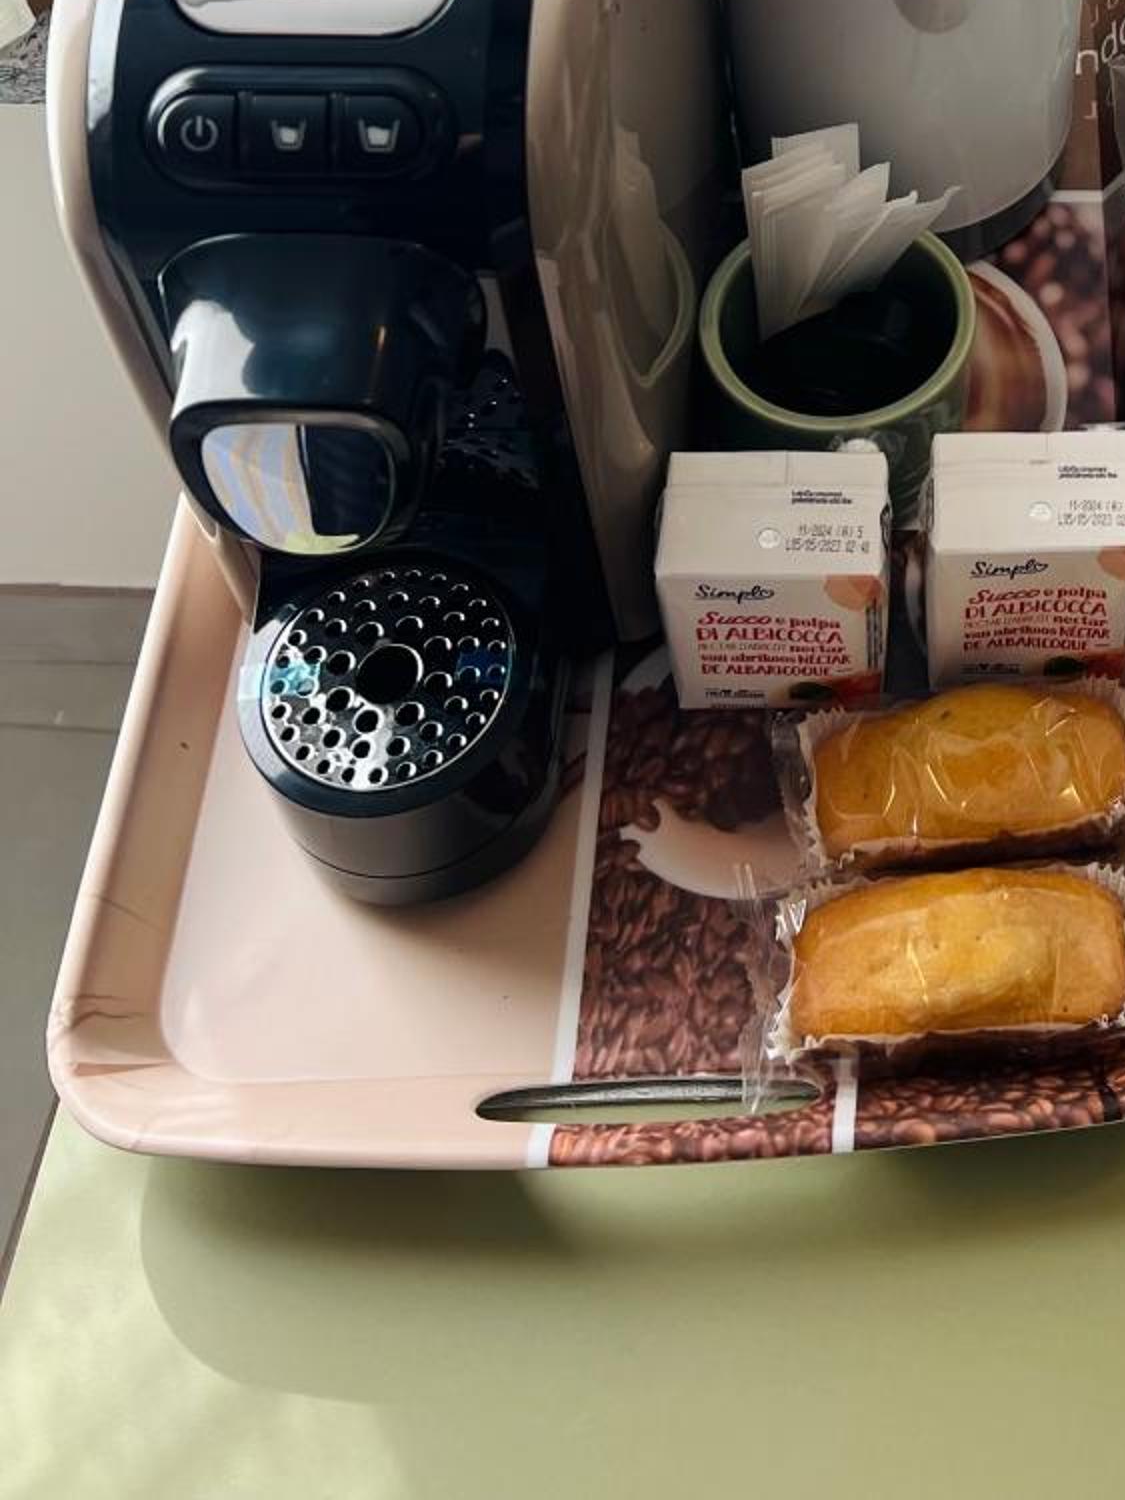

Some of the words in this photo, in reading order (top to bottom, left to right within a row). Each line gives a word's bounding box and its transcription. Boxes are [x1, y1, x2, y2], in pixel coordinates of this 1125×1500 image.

[968, 588, 1041, 604] Succo
[1056, 585, 1107, 600] polpa
[965, 605, 986, 620] DI
[992, 599, 1107, 618] ALBICOCCA
[698, 611, 771, 626] Succo
[789, 616, 841, 630] polpa
[1053, 615, 1108, 627] nectar
[697, 627, 718, 642] DI
[725, 626, 844, 645] ALBICOCCA
[963, 640, 981, 651] DE
[987, 636, 1089, 651] ALBARICOQUE
[789, 645, 846, 654] nectar
[702, 665, 722, 676] DE
[725, 664, 833, 677] ALBARICOQUE
